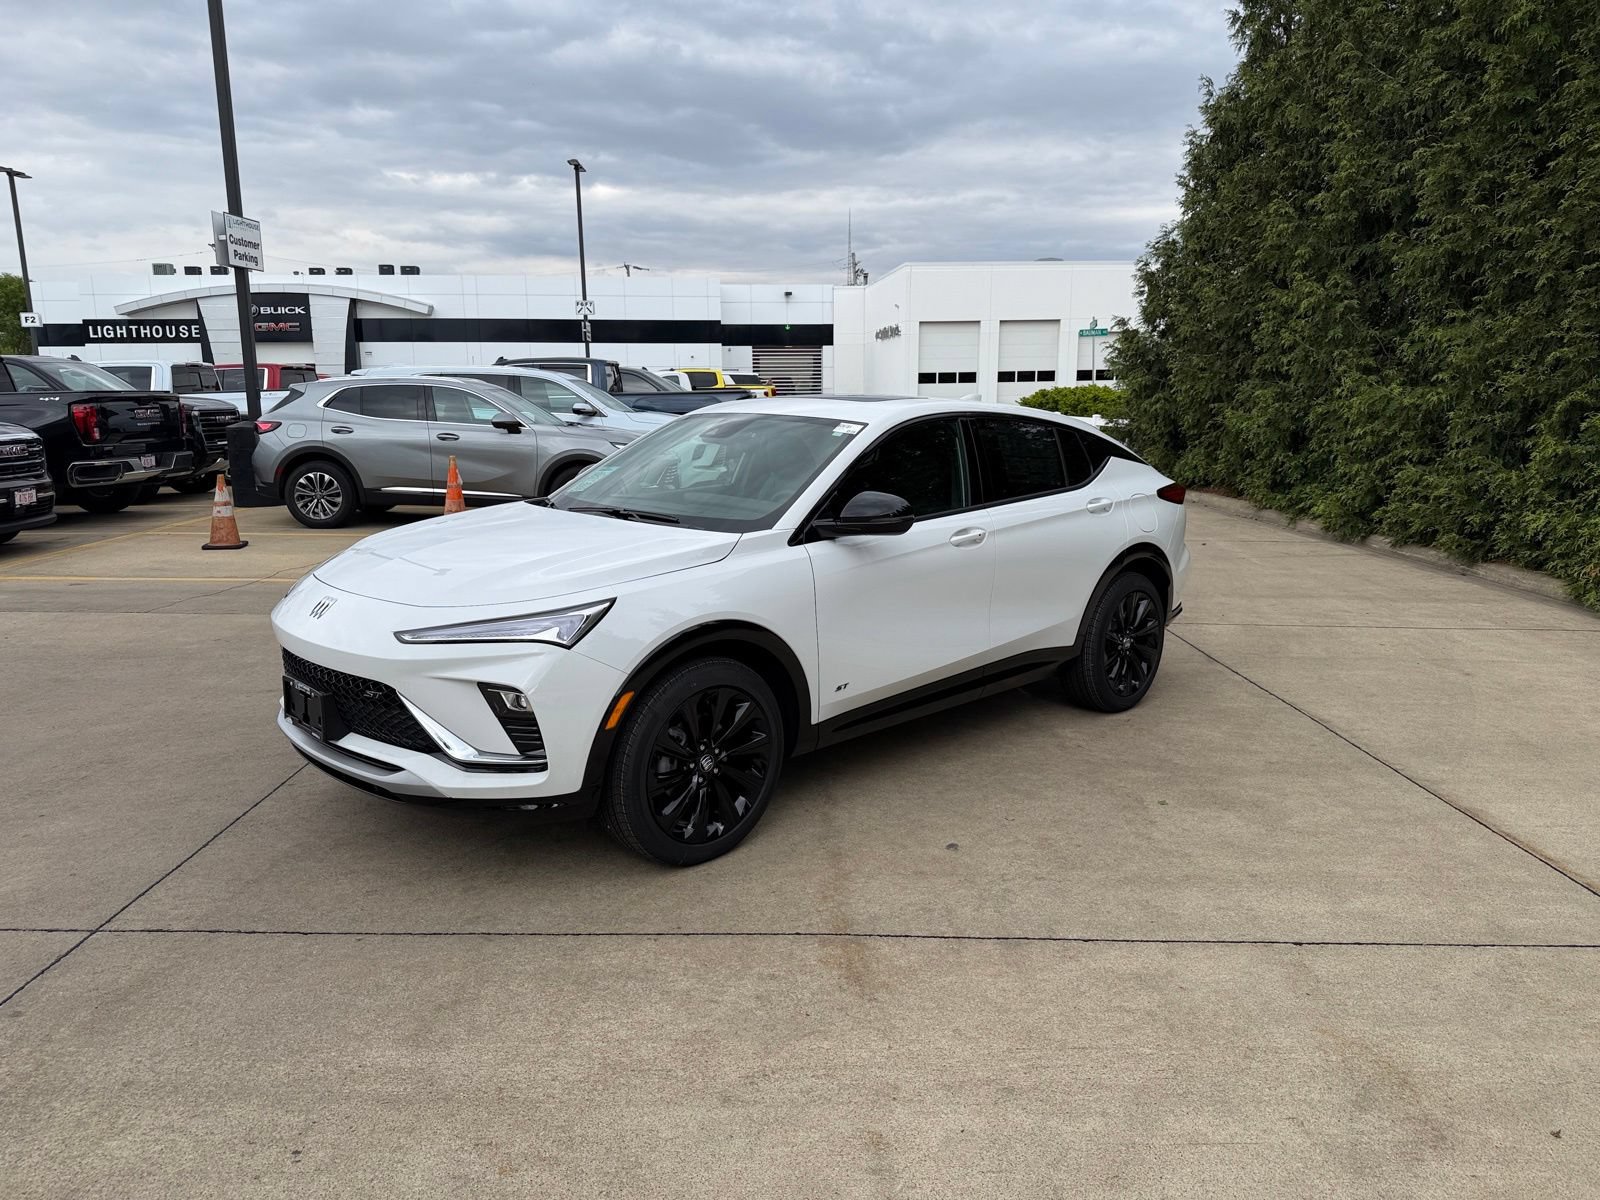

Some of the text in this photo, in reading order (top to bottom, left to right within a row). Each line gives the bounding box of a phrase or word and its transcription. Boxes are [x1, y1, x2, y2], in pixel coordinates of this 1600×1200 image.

[228, 234, 260, 250] Customer
[233, 249, 259, 267] Parking
[260, 305, 306, 315] BUICK
[24, 316, 36, 324] F2
[89, 324, 201, 339] LIGHTHOUSE
[254, 321, 301, 333] GMC
[834, 682, 849, 692] ST
